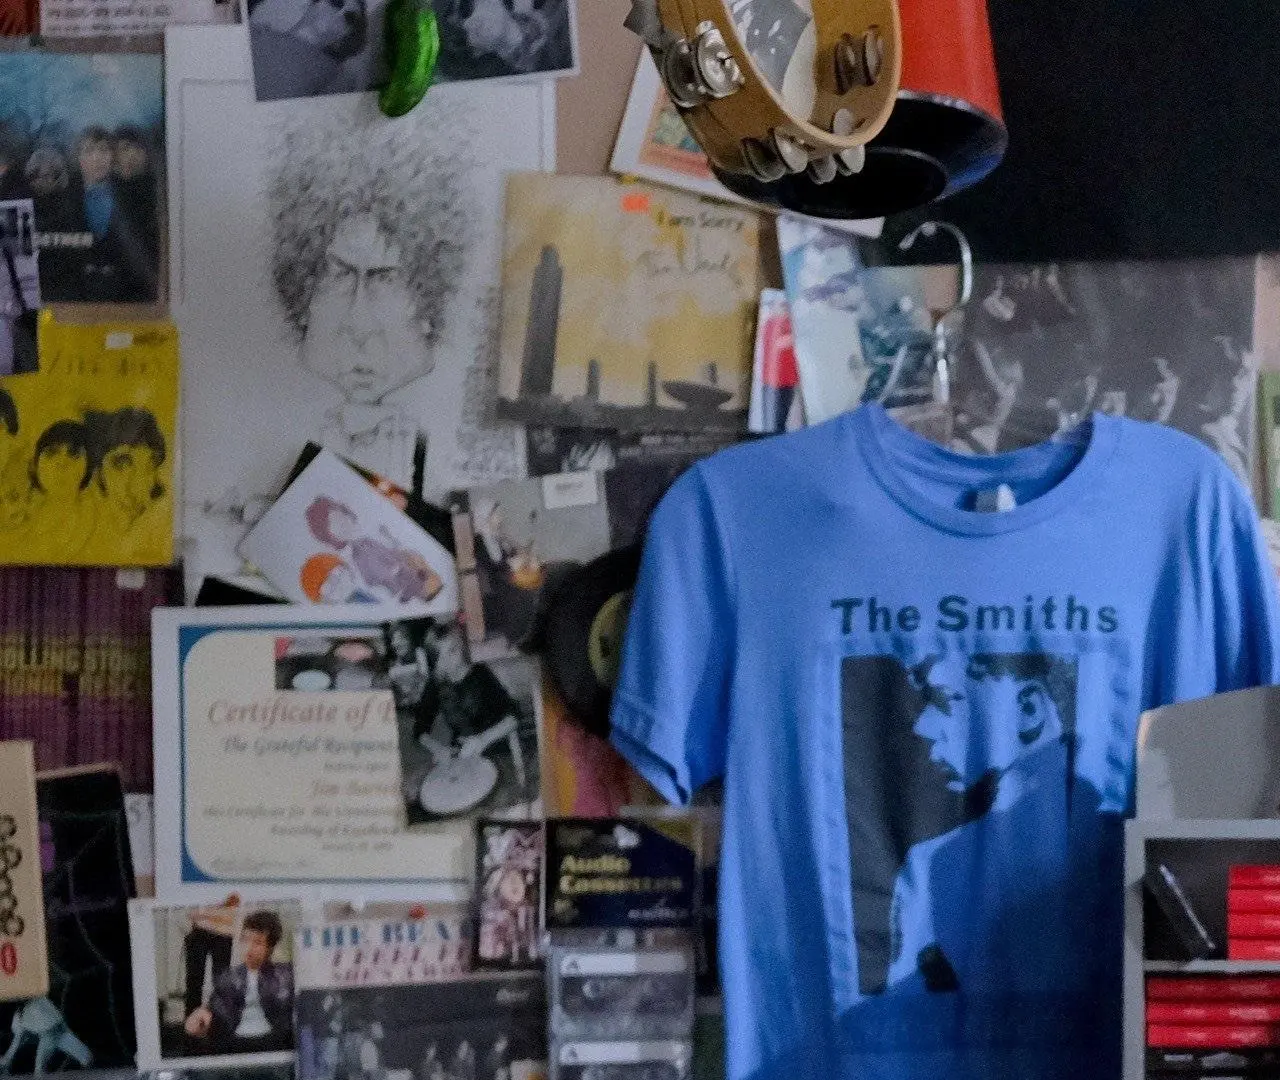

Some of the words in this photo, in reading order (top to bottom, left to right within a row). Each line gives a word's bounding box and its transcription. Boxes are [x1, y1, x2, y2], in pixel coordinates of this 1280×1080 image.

[831, 600, 921, 634] The
[936, 596, 1118, 634] Smiths
[207, 697, 338, 730] Certificate
[345, 694, 378, 732] of
[562, 856, 631, 875] Audio
